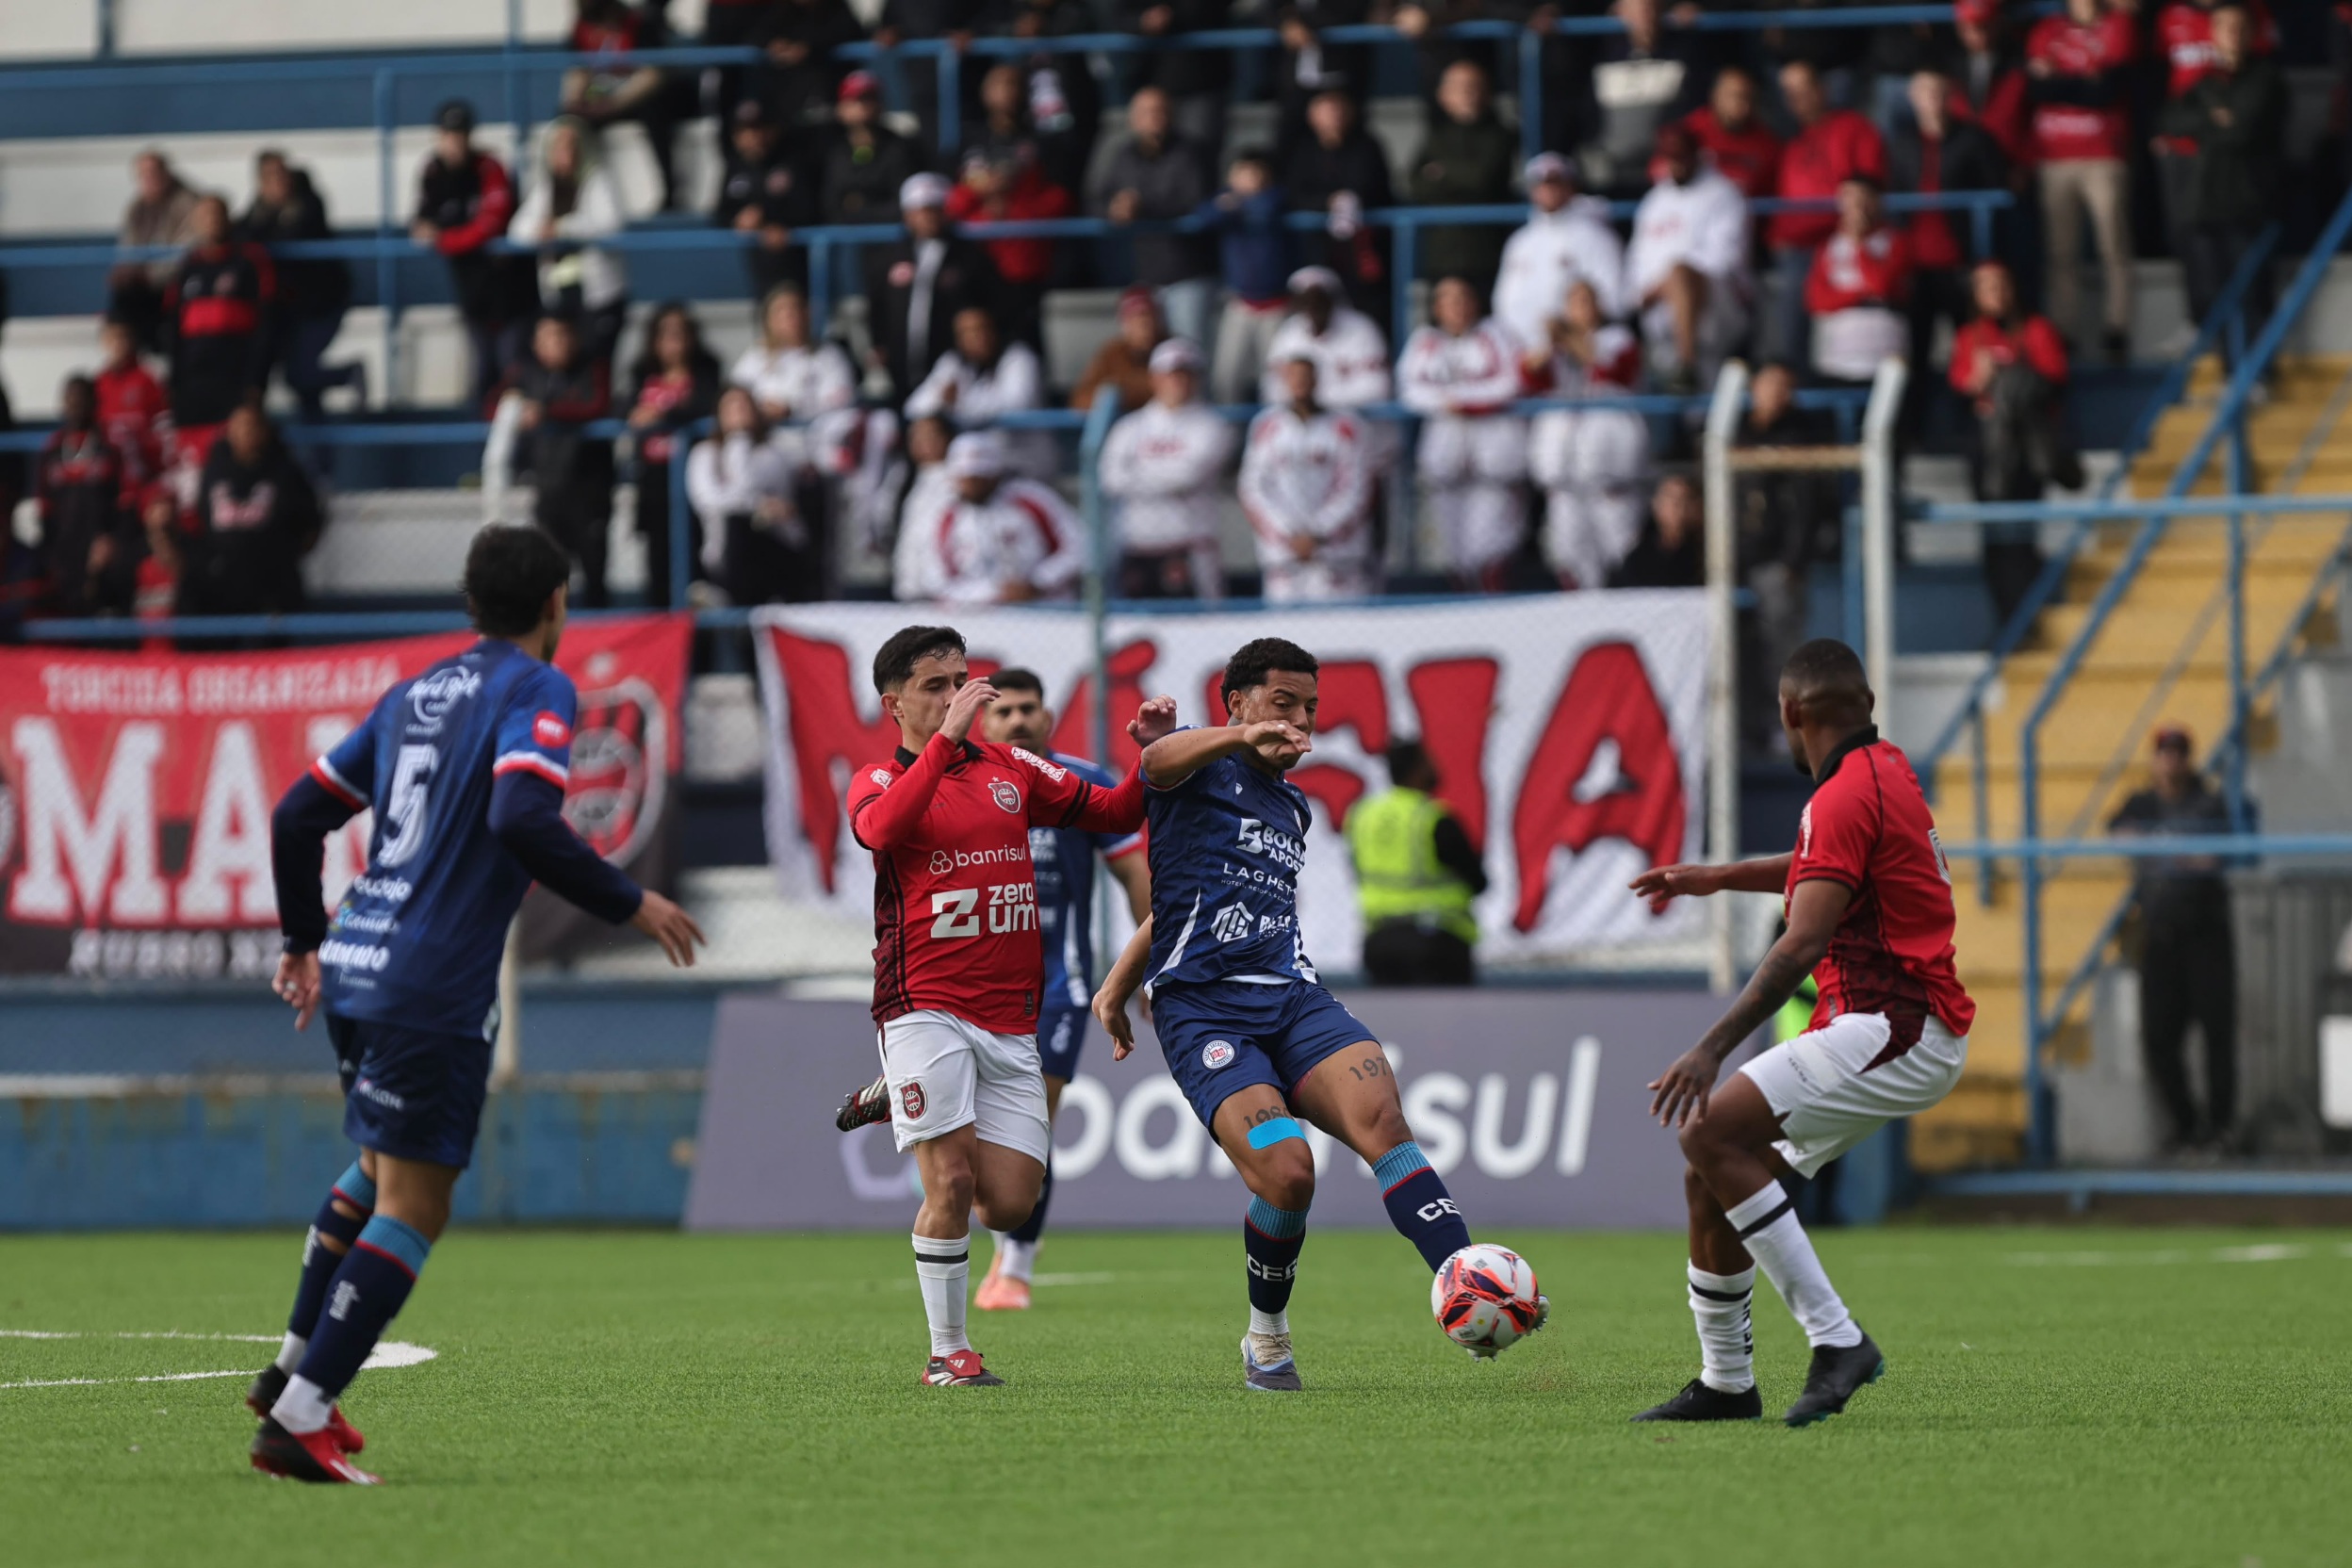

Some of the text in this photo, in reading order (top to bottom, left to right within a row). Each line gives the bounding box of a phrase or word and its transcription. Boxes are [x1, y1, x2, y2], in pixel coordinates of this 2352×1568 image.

[377, 743, 439, 869] 5
[956, 844, 1026, 867] banrisul
[988, 882, 1034, 906] zero
[989, 903, 1036, 934] um
[1349, 1056, 1388, 1082] 197
